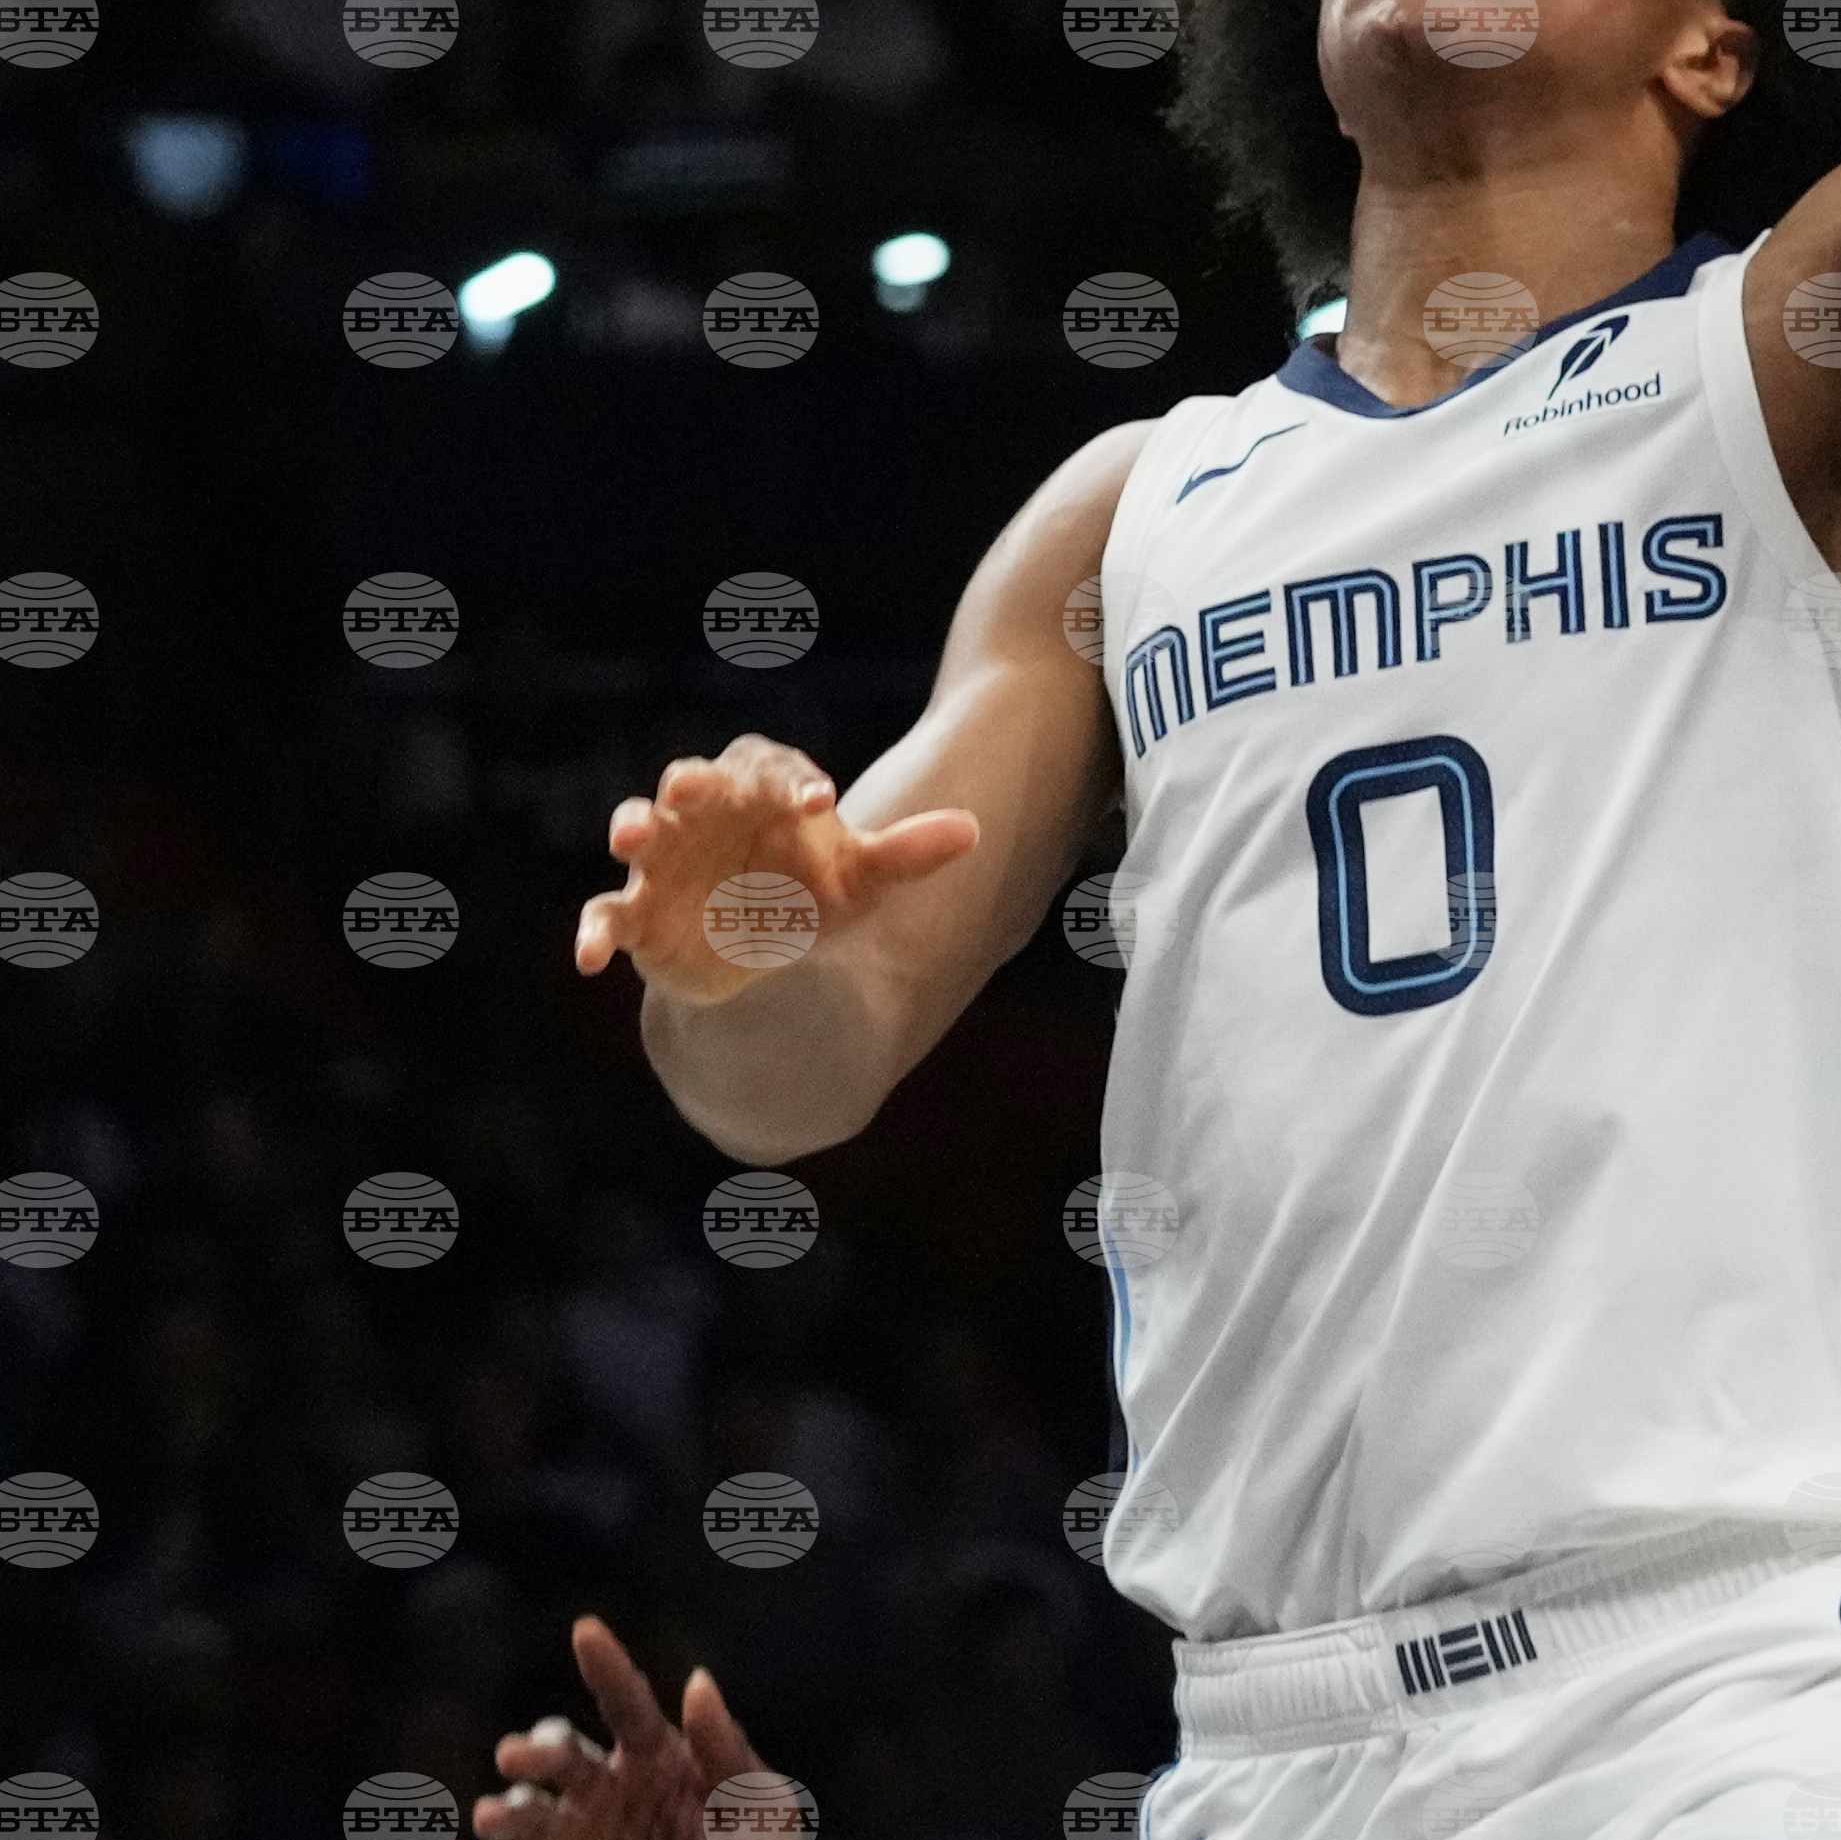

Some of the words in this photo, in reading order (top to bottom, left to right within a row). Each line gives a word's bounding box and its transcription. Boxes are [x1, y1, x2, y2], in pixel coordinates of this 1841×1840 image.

[1503, 370, 1663, 437] Robinhood
[1125, 513, 1728, 759] MEMPHIS
[1306, 734, 1497, 1017] 0
